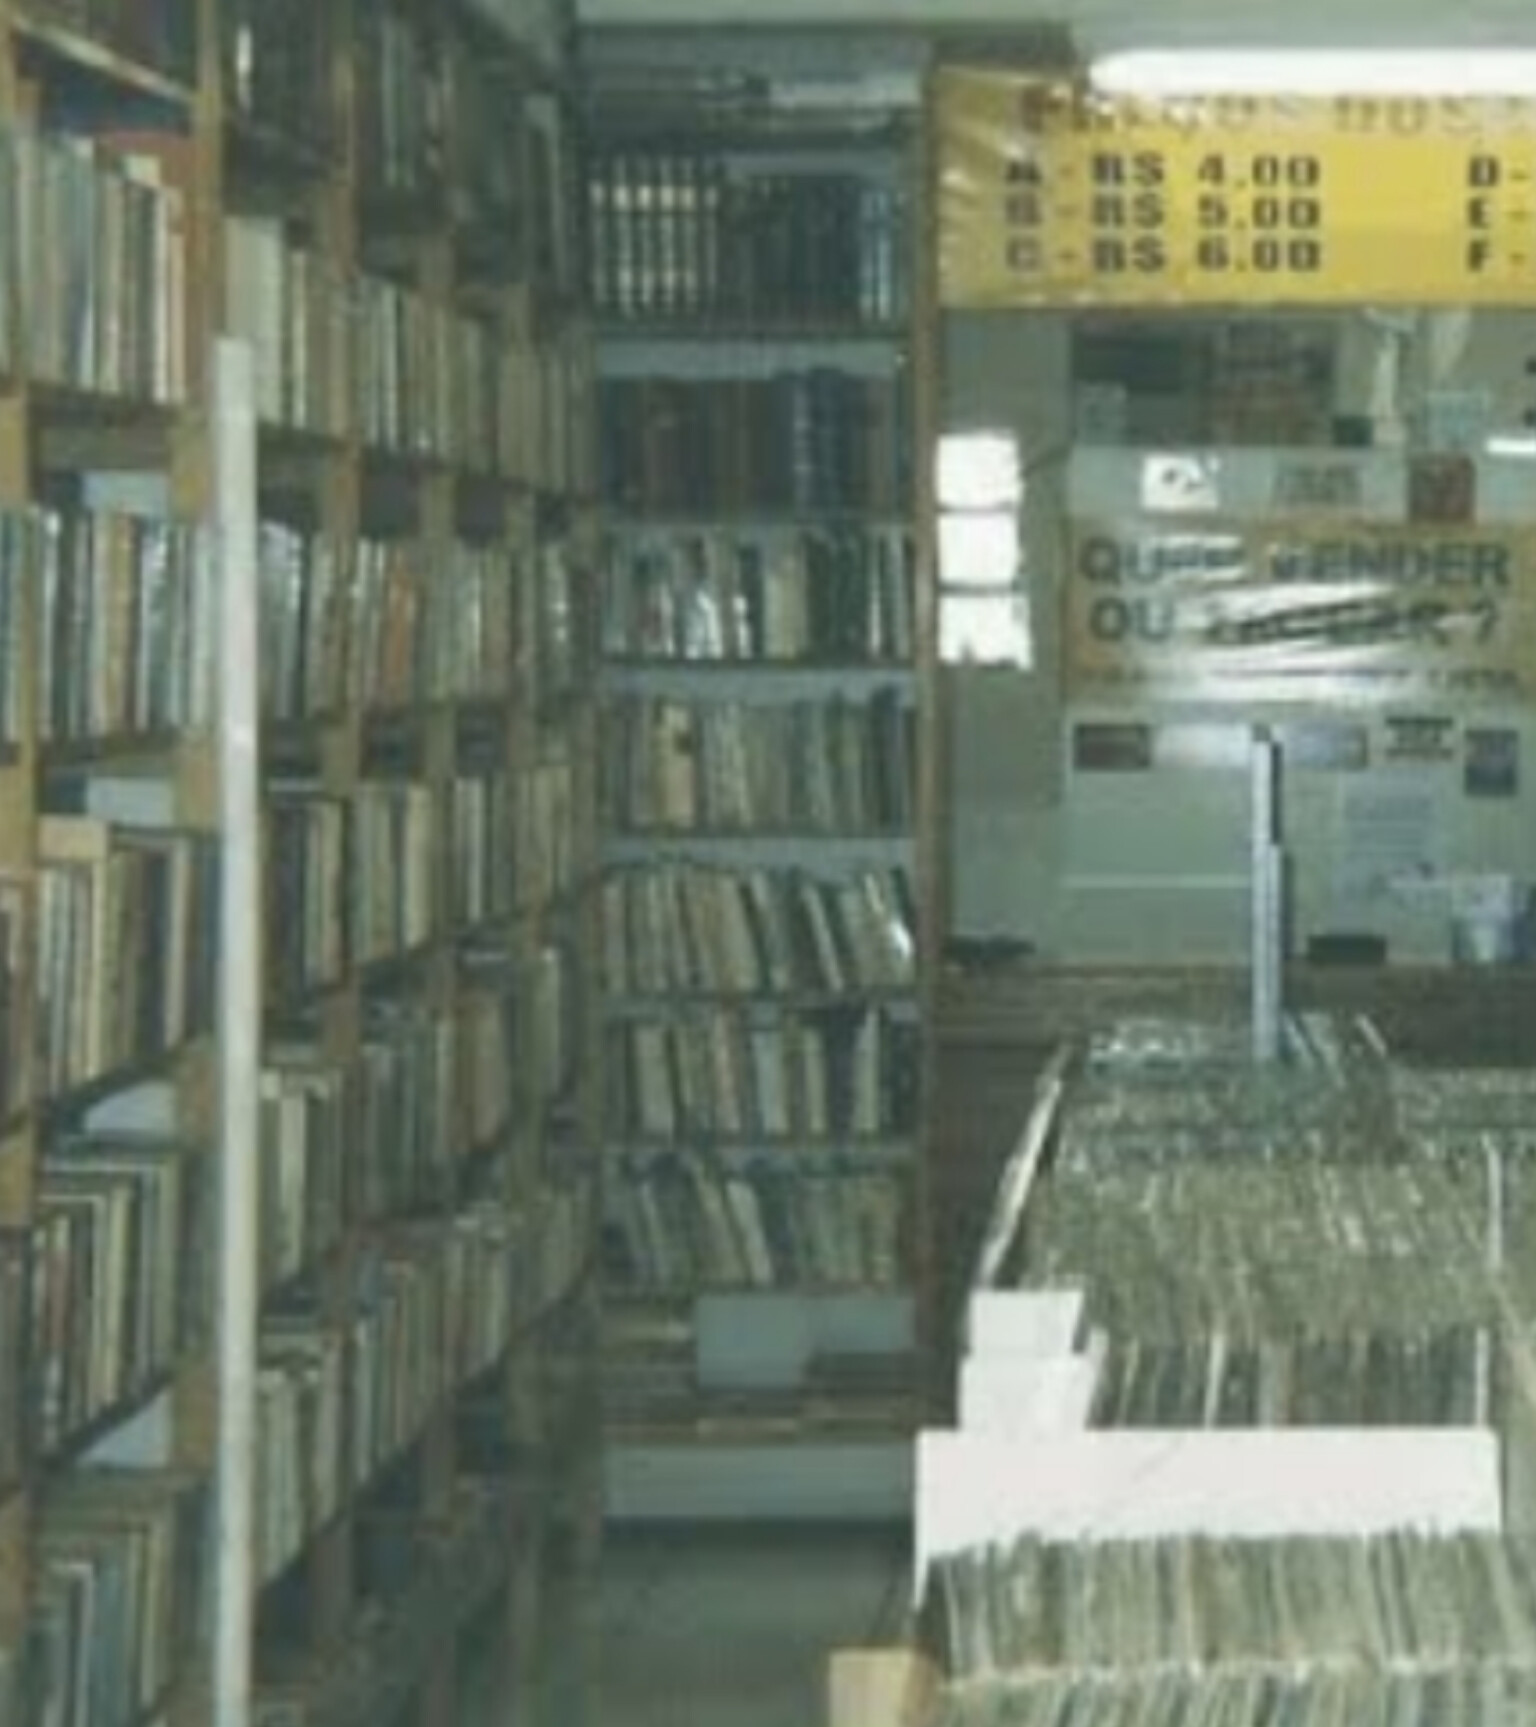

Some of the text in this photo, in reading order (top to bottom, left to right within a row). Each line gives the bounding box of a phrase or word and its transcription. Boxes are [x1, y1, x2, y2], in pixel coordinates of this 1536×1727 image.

[1199, 153, 1321, 188] 4.00
[1199, 195, 1321, 231] 5.00
[1199, 236, 1321, 273] 6.00
